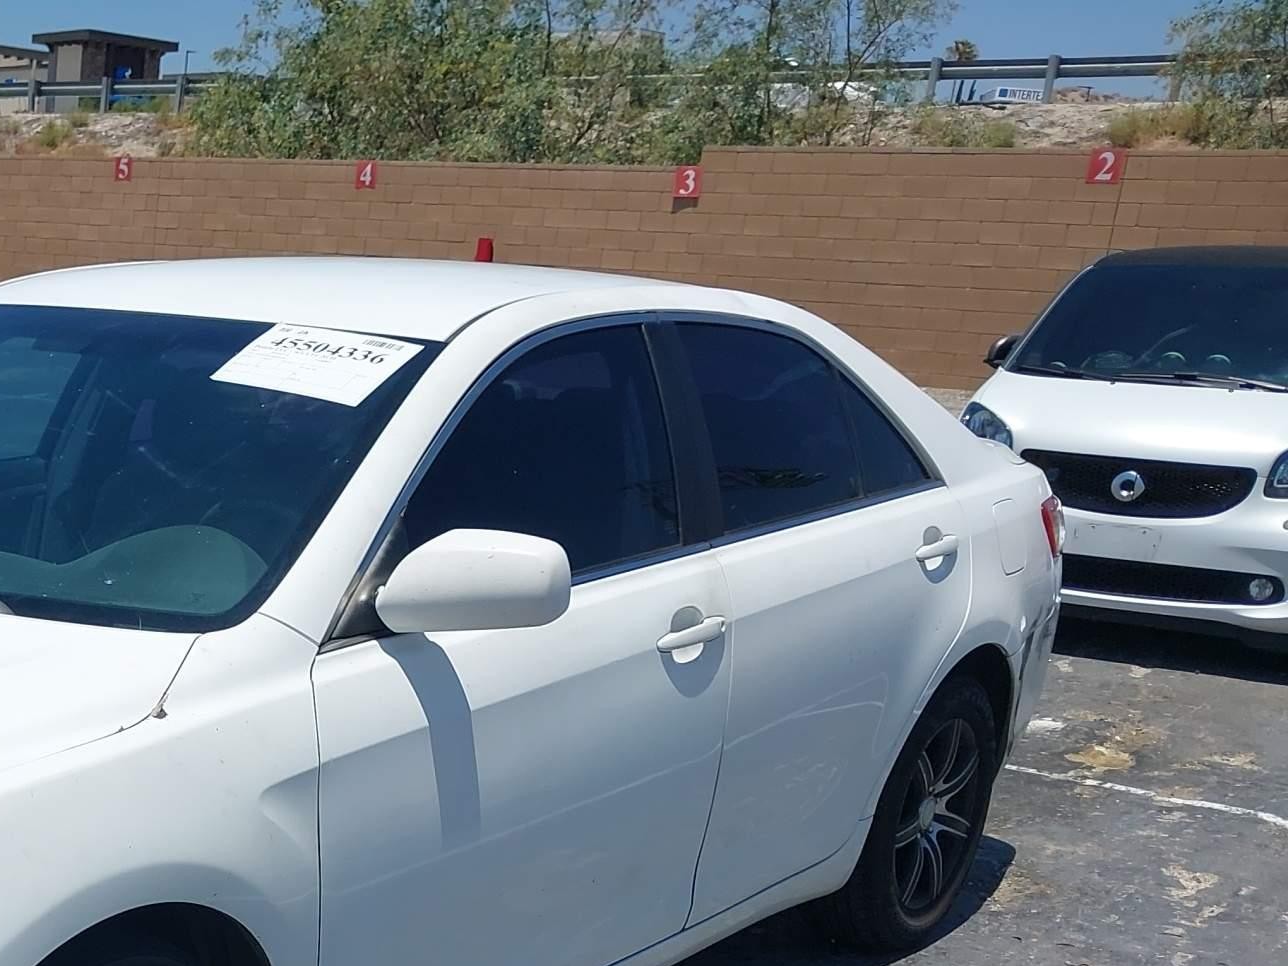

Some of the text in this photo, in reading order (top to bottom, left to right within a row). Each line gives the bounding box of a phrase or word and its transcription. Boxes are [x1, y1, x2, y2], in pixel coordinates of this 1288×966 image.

[1008, 89, 1043, 101] INTERTE
[118, 157, 129, 179] 5
[360, 161, 372, 186] 4
[1094, 151, 1115, 180] 2
[679, 169, 696, 194] 3
[270, 336, 390, 365] 45504336
